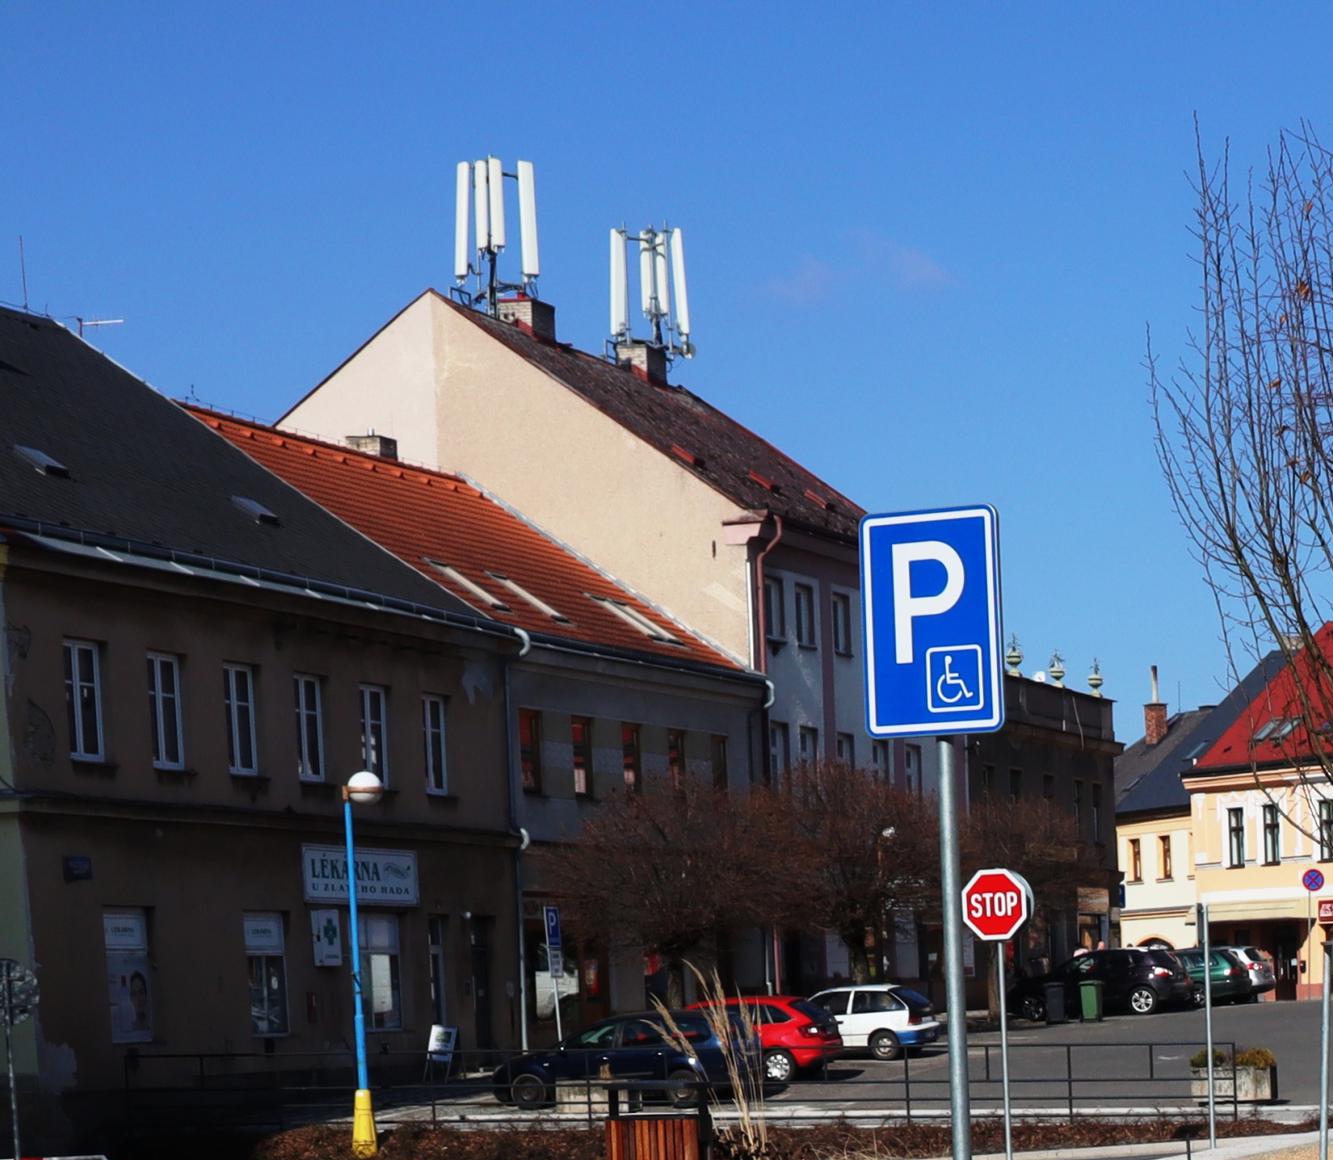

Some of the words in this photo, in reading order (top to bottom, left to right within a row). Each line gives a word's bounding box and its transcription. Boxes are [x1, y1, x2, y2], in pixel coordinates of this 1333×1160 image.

[892, 540, 965, 664] P
[970, 891, 1018, 918] STOP
[548, 911, 557, 935] P
